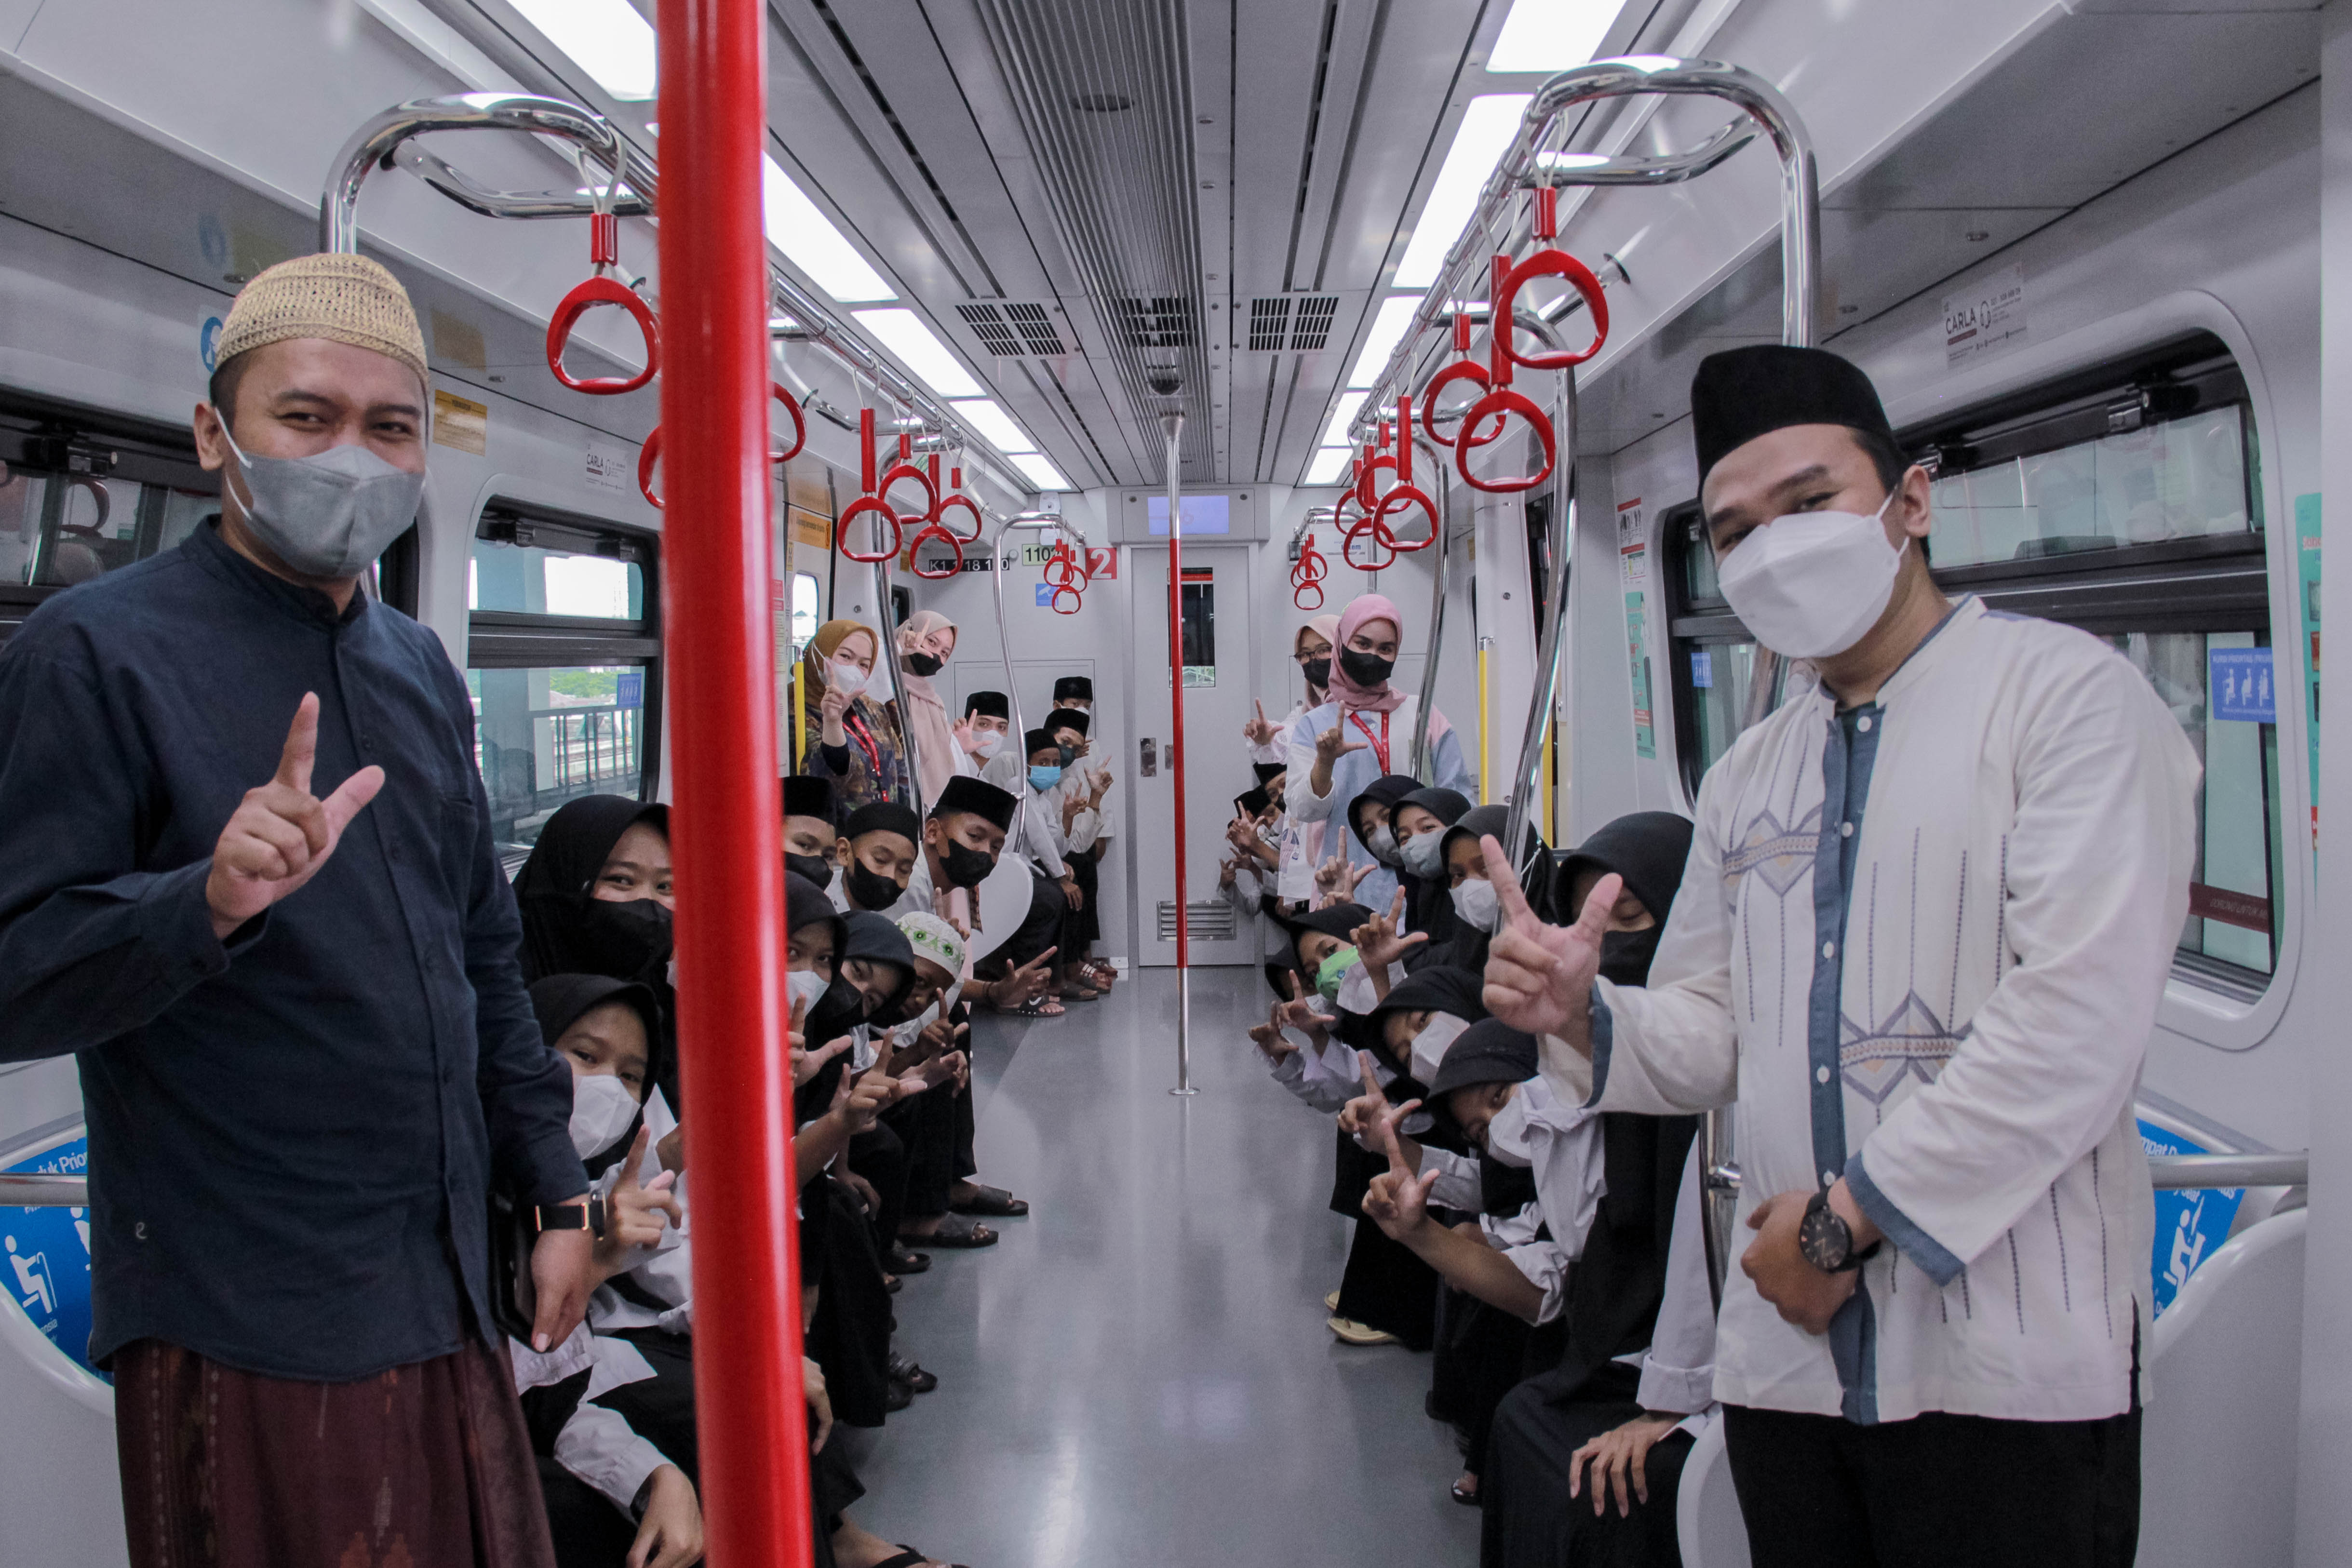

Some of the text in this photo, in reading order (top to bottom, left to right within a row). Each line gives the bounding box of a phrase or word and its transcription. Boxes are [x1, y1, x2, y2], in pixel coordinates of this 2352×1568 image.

[1946, 308, 1976, 334] CARLA
[587, 454, 604, 469] CARLA
[930, 560, 946, 570] K1
[965, 560, 981, 571] 18
[985, 559, 1009, 571] 10
[1090, 549, 1112, 578] 2
